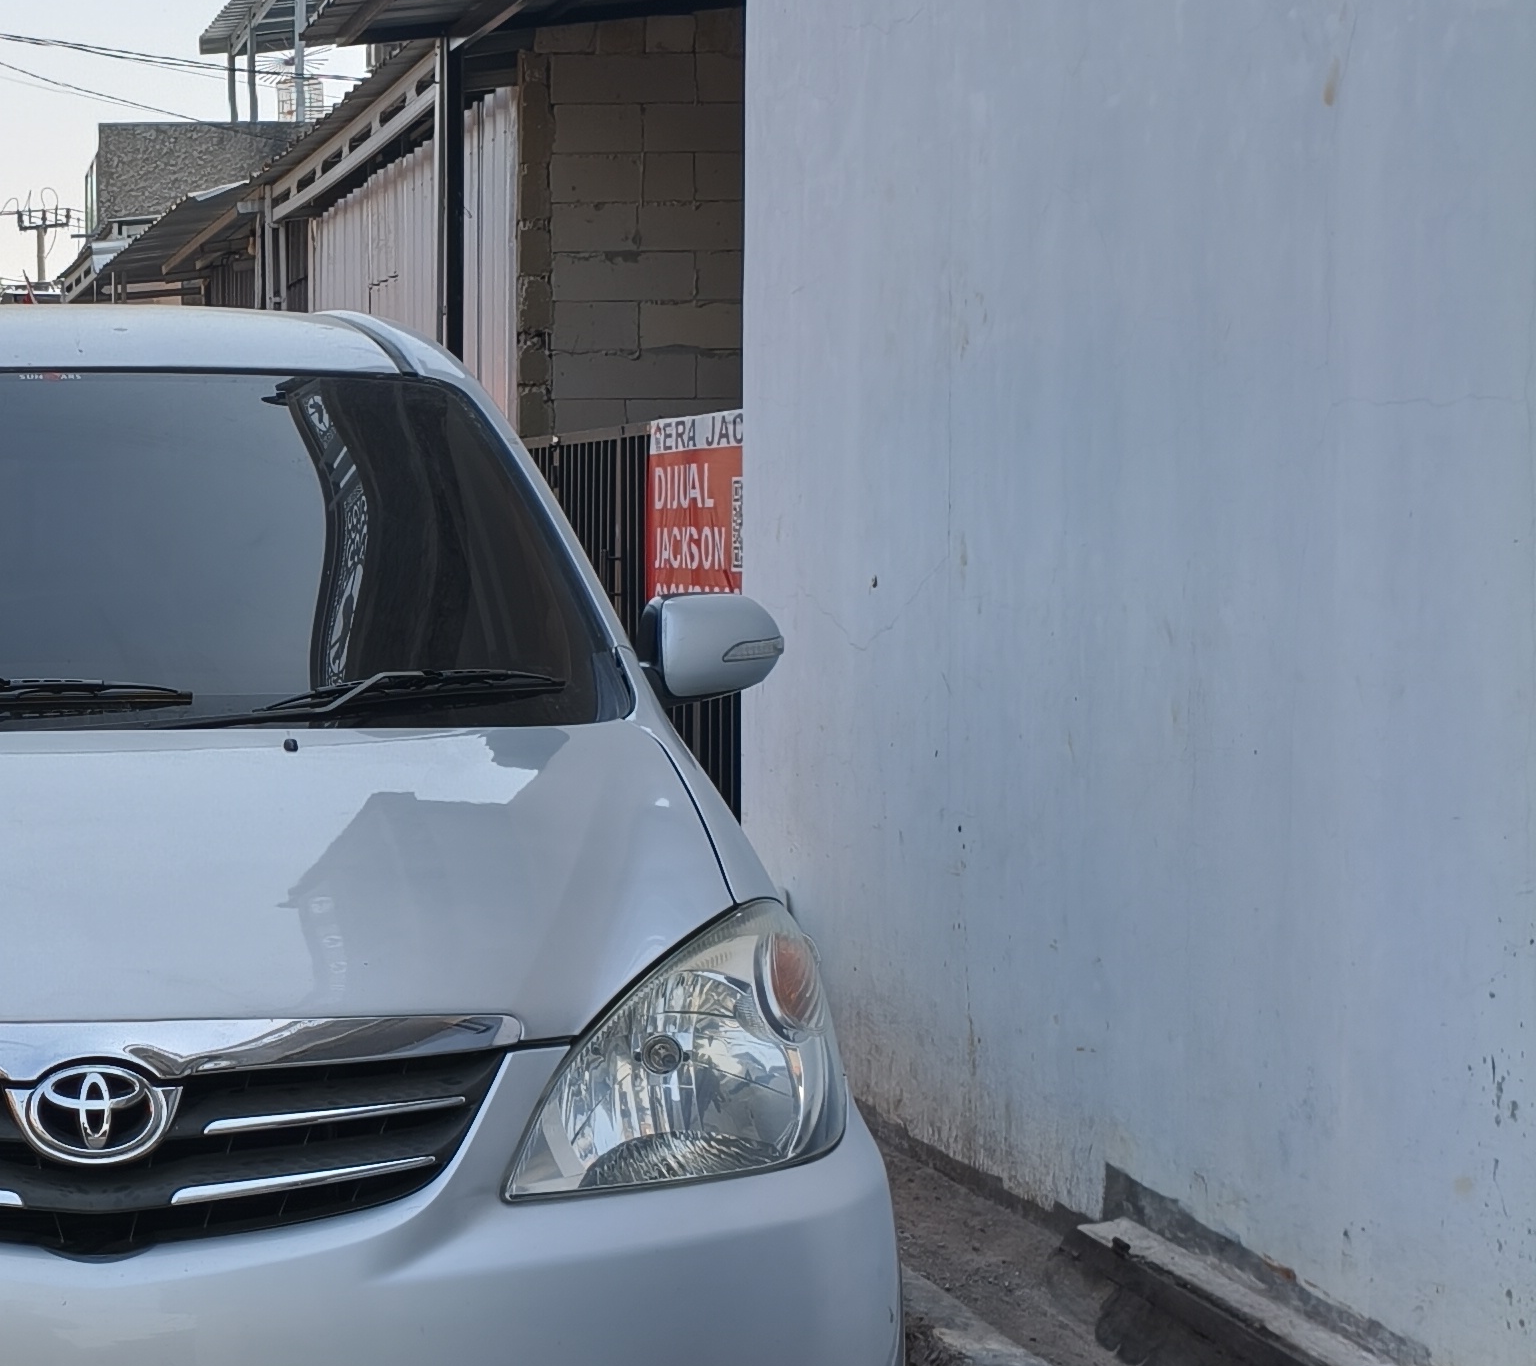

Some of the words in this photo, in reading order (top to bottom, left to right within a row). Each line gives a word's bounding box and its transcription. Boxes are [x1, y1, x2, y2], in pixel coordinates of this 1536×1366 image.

[662, 419, 697, 451] ERA
[654, 463, 715, 510] DIJUAL
[654, 525, 725, 571] JACKSON
